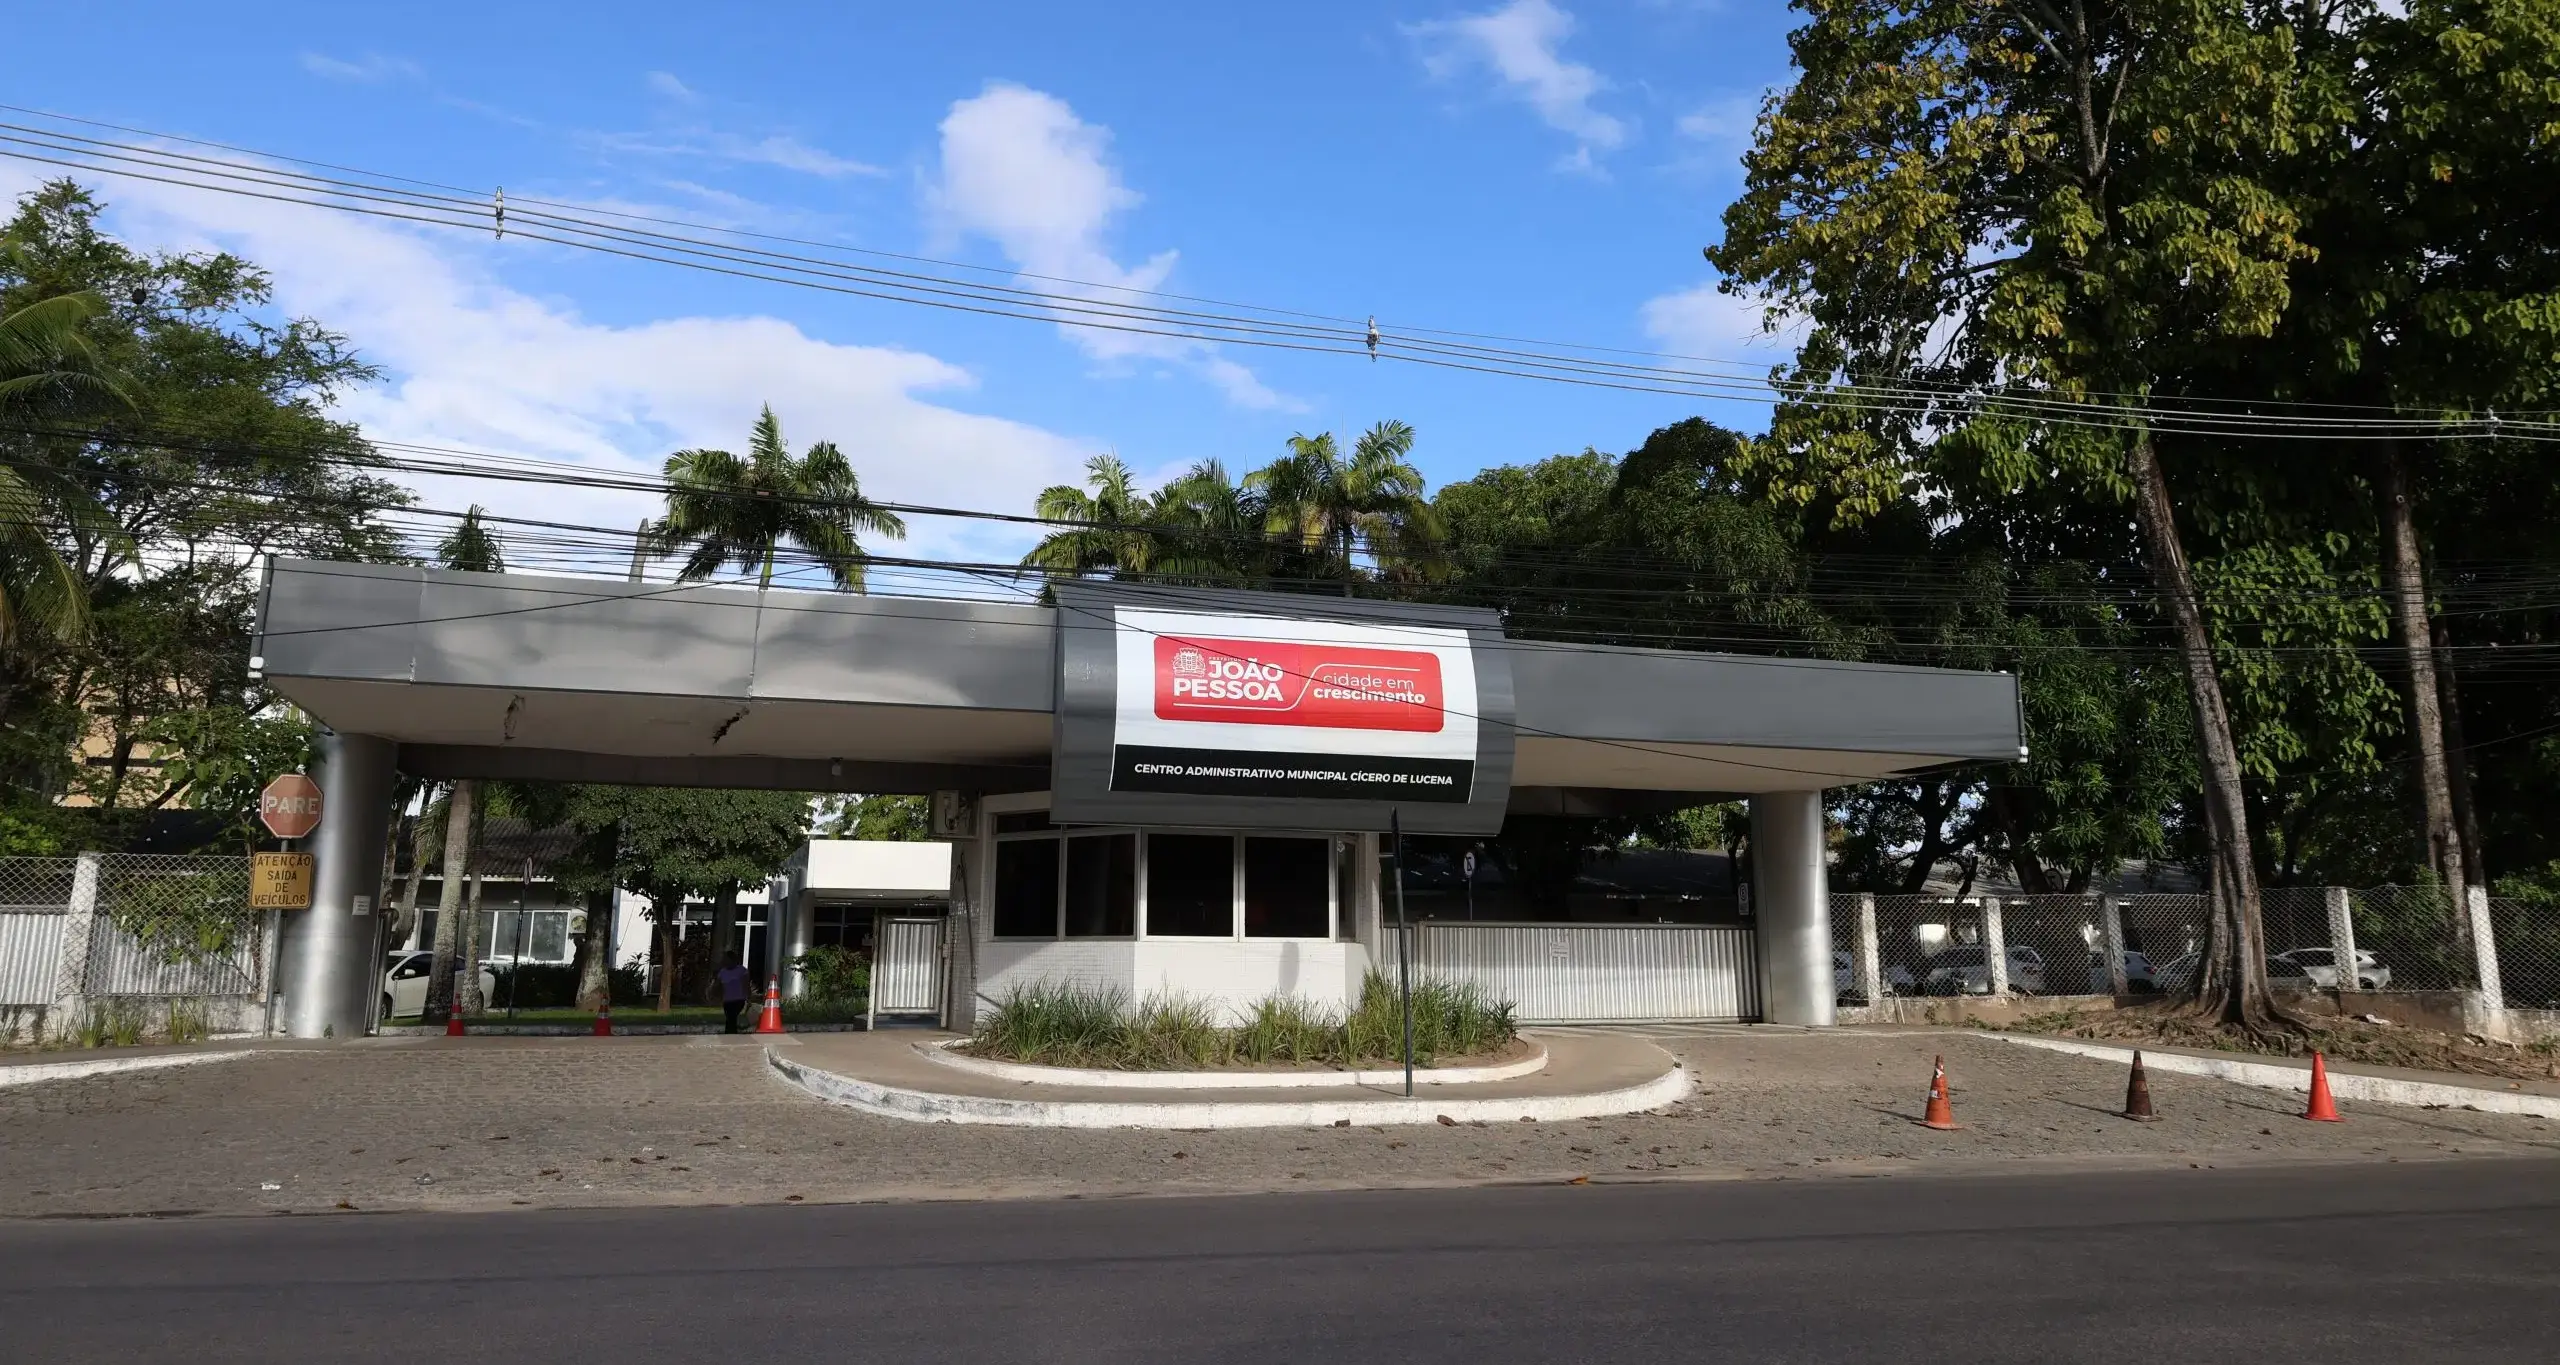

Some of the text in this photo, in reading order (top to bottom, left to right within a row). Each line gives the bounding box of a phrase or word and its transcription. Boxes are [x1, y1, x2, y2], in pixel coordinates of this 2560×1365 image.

[1208, 657, 1284, 682] JOÃO
[1173, 677, 1284, 701] PESSOA
[1322, 673, 1414, 690] cidade em
[1313, 687, 1426, 704] crescimento
[1134, 763, 1453, 785] CENTRO ADMINISTRATIVO MUNICIPAL CÍCERO DE LUCENA
[265, 796, 320, 815] PARE
[257, 854, 311, 868] ATENÇÃO
[267, 869, 297, 881] SAÍDA
[275, 882, 289, 893] DE
[254, 893, 306, 906] VEÍCULOS
